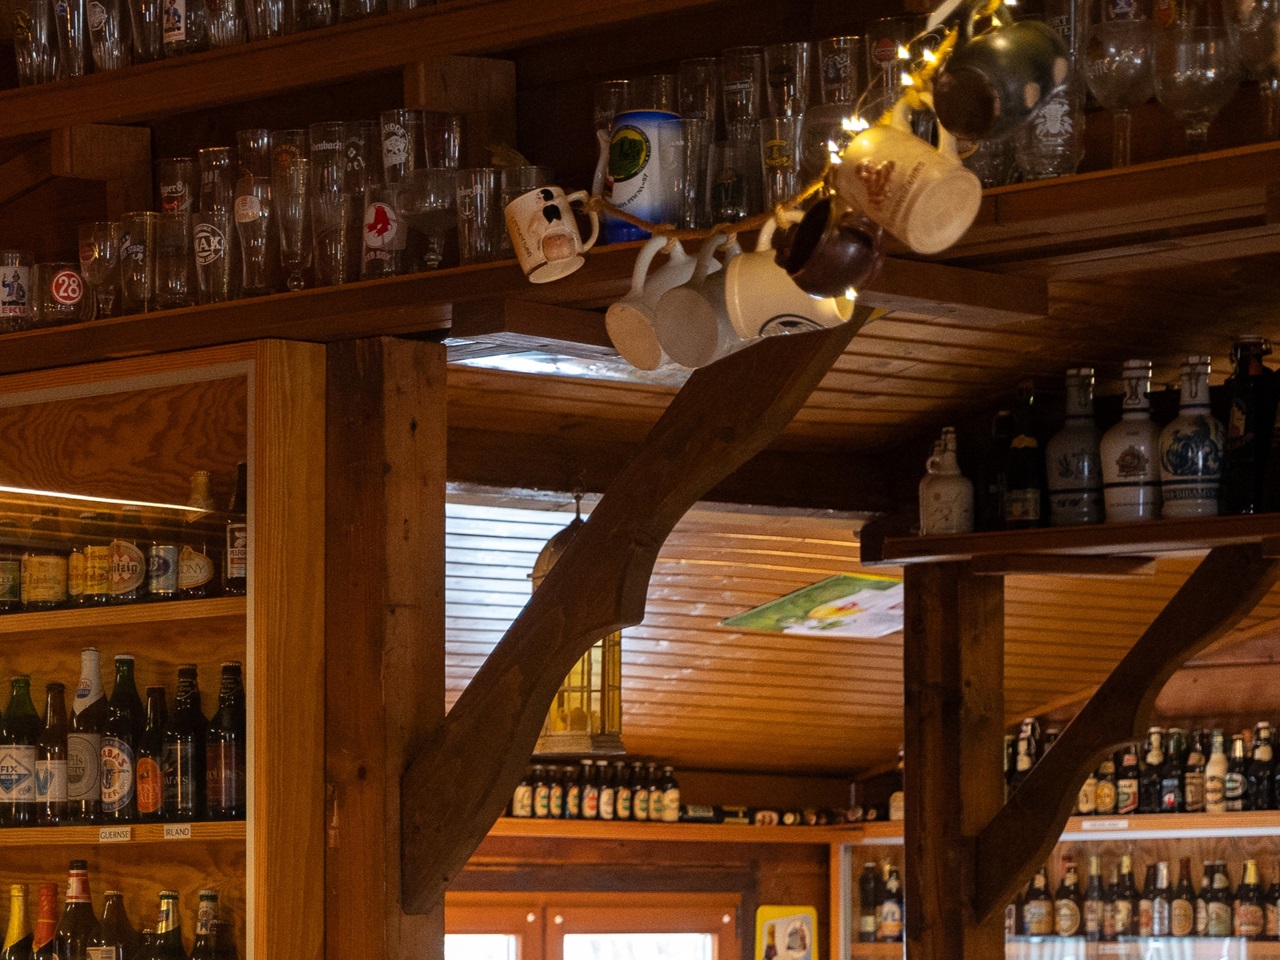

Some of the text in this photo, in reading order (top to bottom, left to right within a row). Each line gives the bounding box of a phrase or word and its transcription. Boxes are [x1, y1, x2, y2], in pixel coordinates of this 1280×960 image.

[58, 275, 81, 298] 28
[1, 306, 26, 315] EKU
[164, 828, 191, 839] IRLAND
